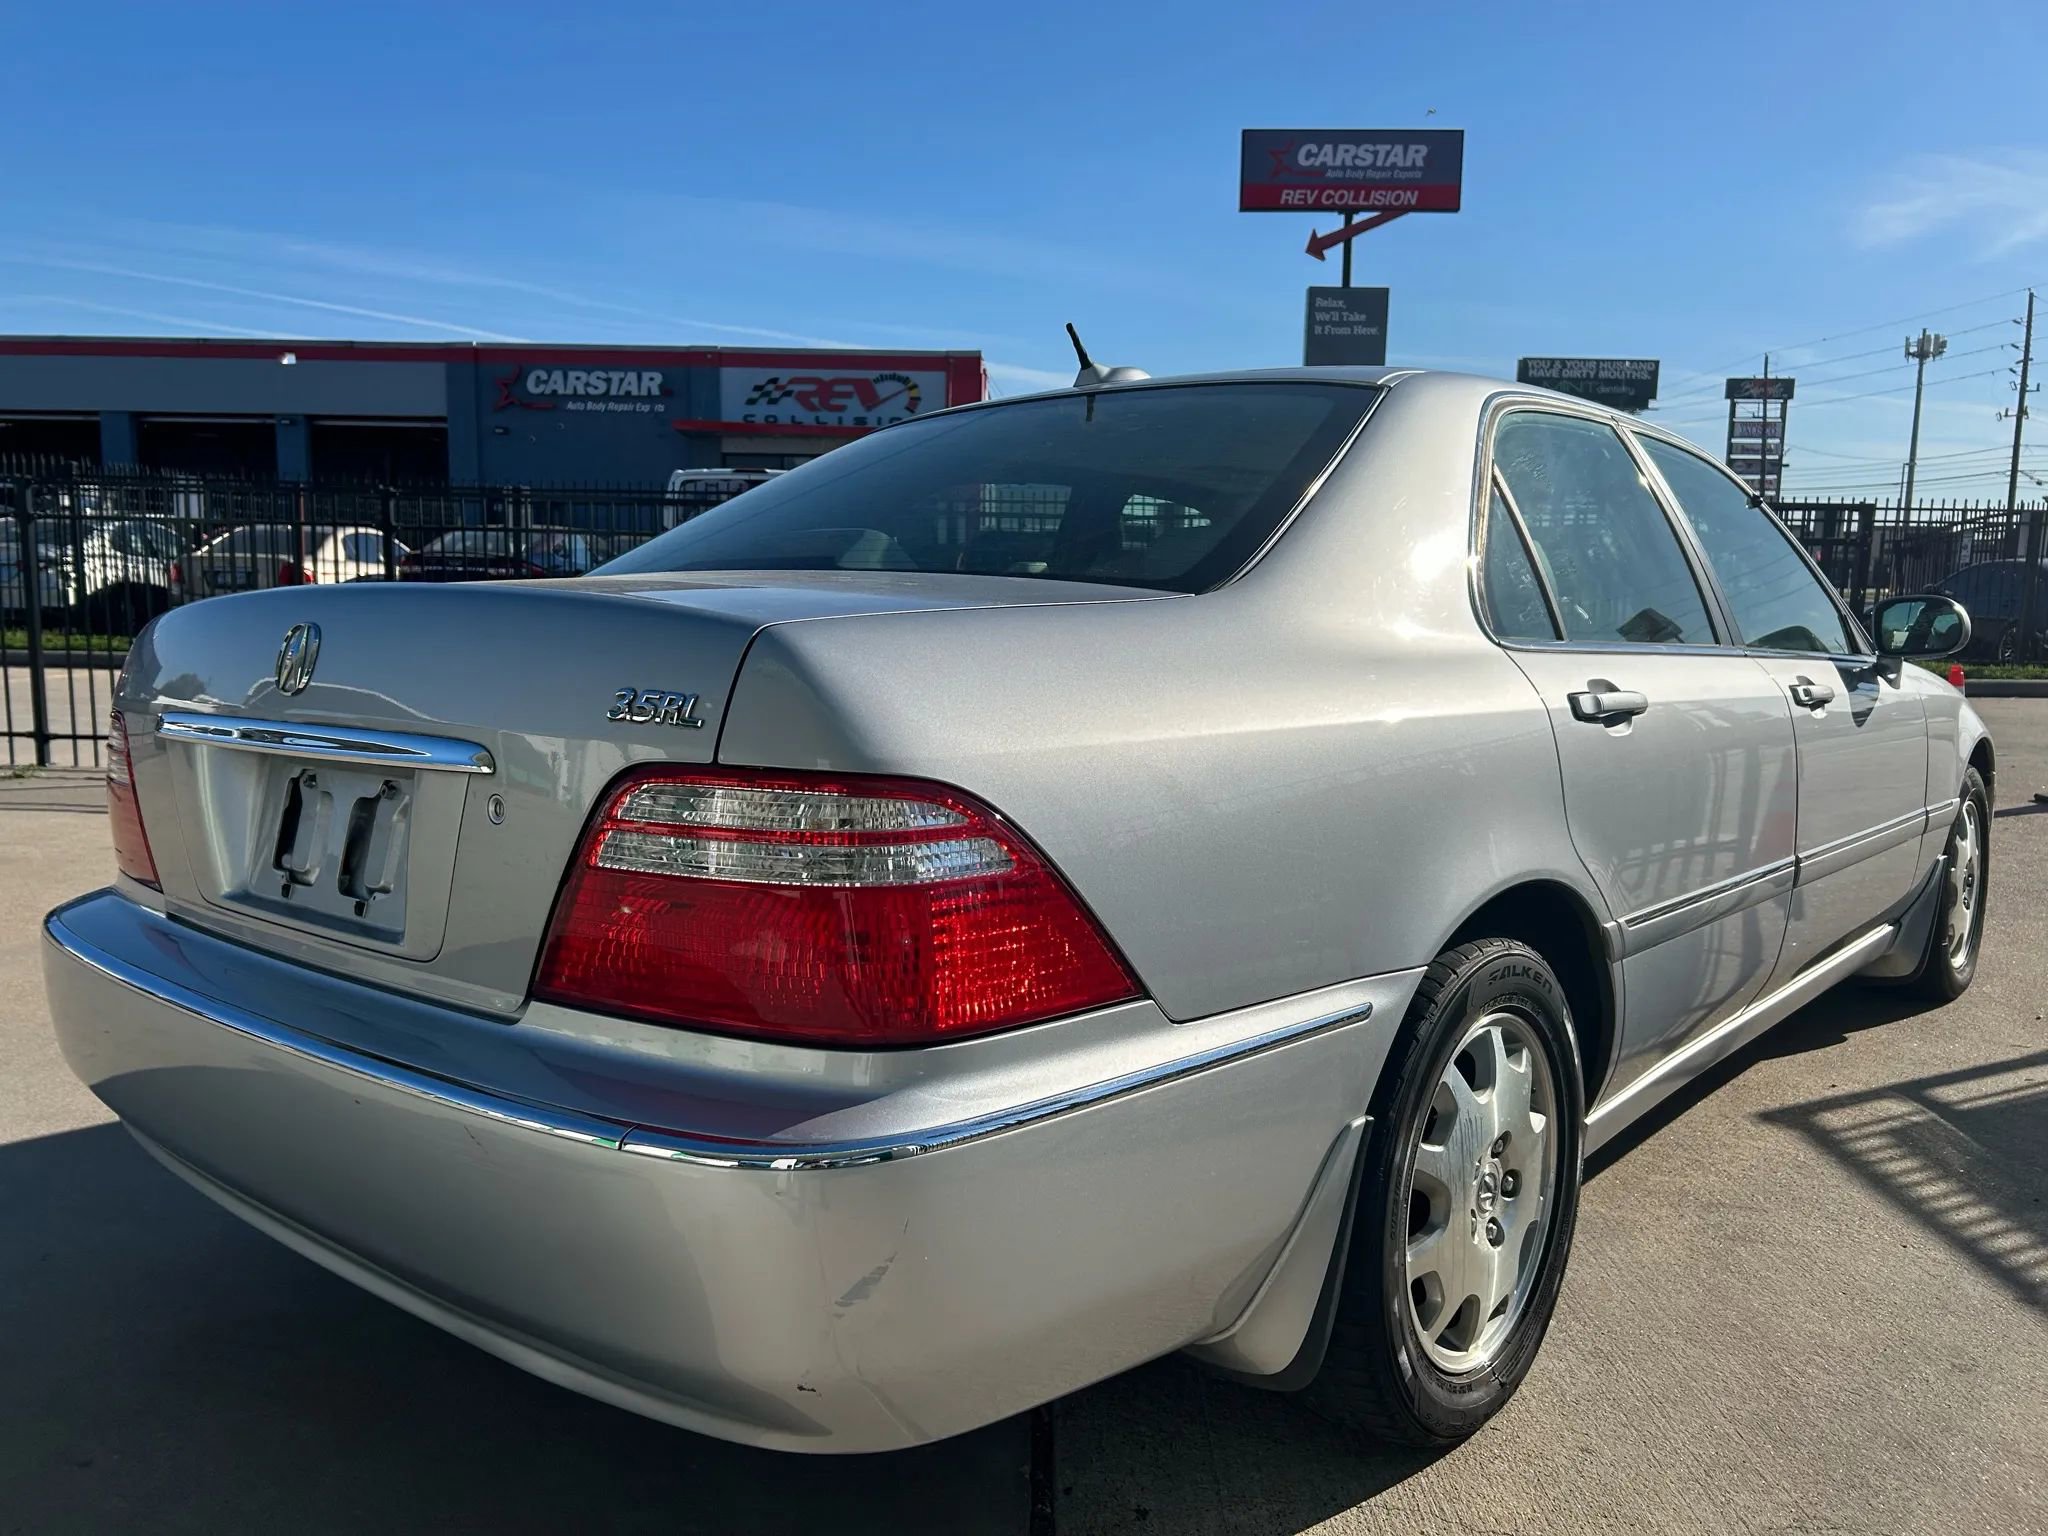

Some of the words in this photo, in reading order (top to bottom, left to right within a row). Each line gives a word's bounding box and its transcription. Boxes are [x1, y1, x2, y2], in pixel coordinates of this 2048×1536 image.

[1297, 143, 1428, 167] CARSTAR
[1325, 168, 1343, 178] Auto
[1345, 168, 1364, 179] Body
[1366, 169, 1392, 179] Repair
[1393, 169, 1422, 179] Experts
[1280, 189, 1319, 205] REV
[1321, 189, 1419, 206] COLLISION
[1315, 297, 1347, 309] Relax,
[1341, 311, 1366, 321] Take
[1314, 325, 1322, 335] It
[1324, 325, 1351, 335] From
[1527, 359, 1553, 370] YOU
[1554, 360, 1562, 369] &
[1565, 360, 1597, 370] YOUR
[1528, 368, 1560, 378] HAVE
[1562, 369, 1594, 379] DIRTY
[526, 369, 663, 396] CARSTAR
[782, 376, 898, 413] REV
[567, 401, 585, 411] Auto
[586, 401, 606, 413] Body
[607, 402, 634, 413] Repair
[635, 402, 665, 413] Exprts
[743, 414, 903, 426] COLLISI
[1487, 964, 1554, 994] FALKEN
